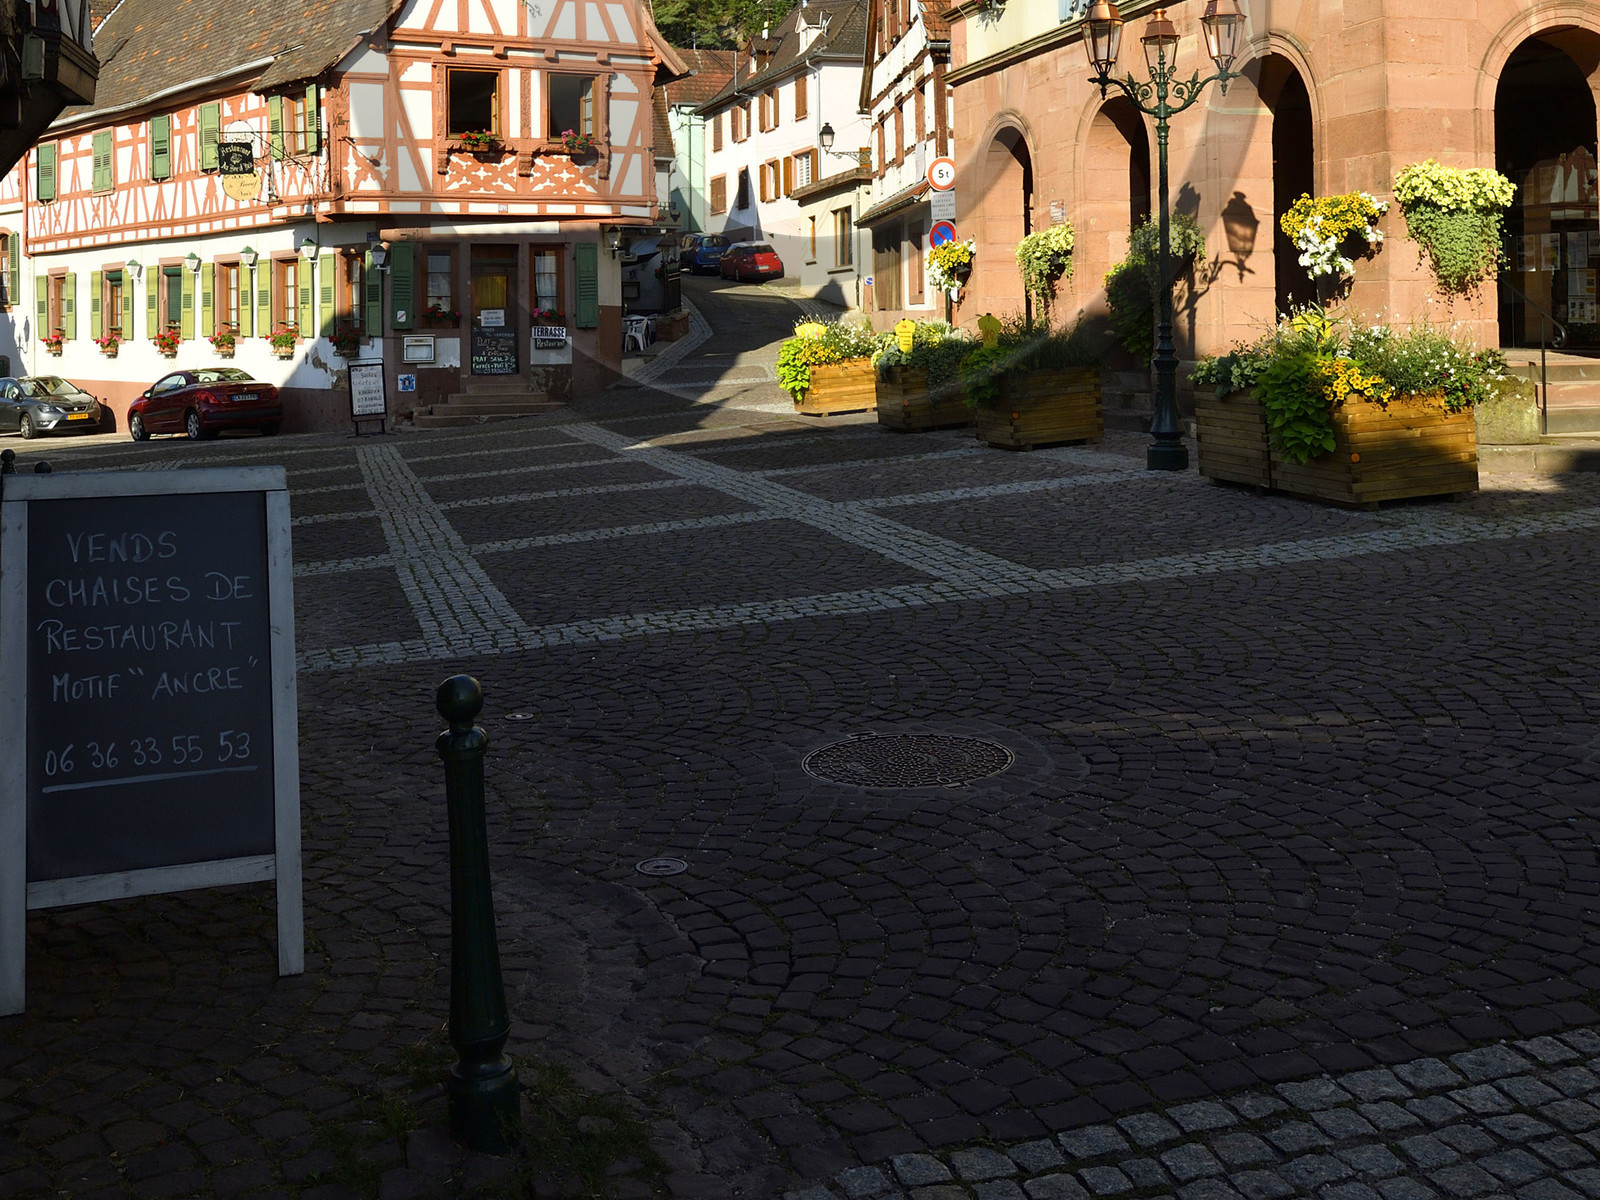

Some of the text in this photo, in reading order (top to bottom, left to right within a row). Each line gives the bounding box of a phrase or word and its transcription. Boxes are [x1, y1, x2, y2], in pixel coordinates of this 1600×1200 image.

[533, 327, 564, 337] TERRASSE
[536, 338, 565, 348] Restaurant
[66, 531, 178, 564] VENDS
[46, 572, 253, 607] CHAISES DE
[37, 619, 240, 656] RESTAURANT
[45, 731, 250, 776] 06 36 33 55 53
